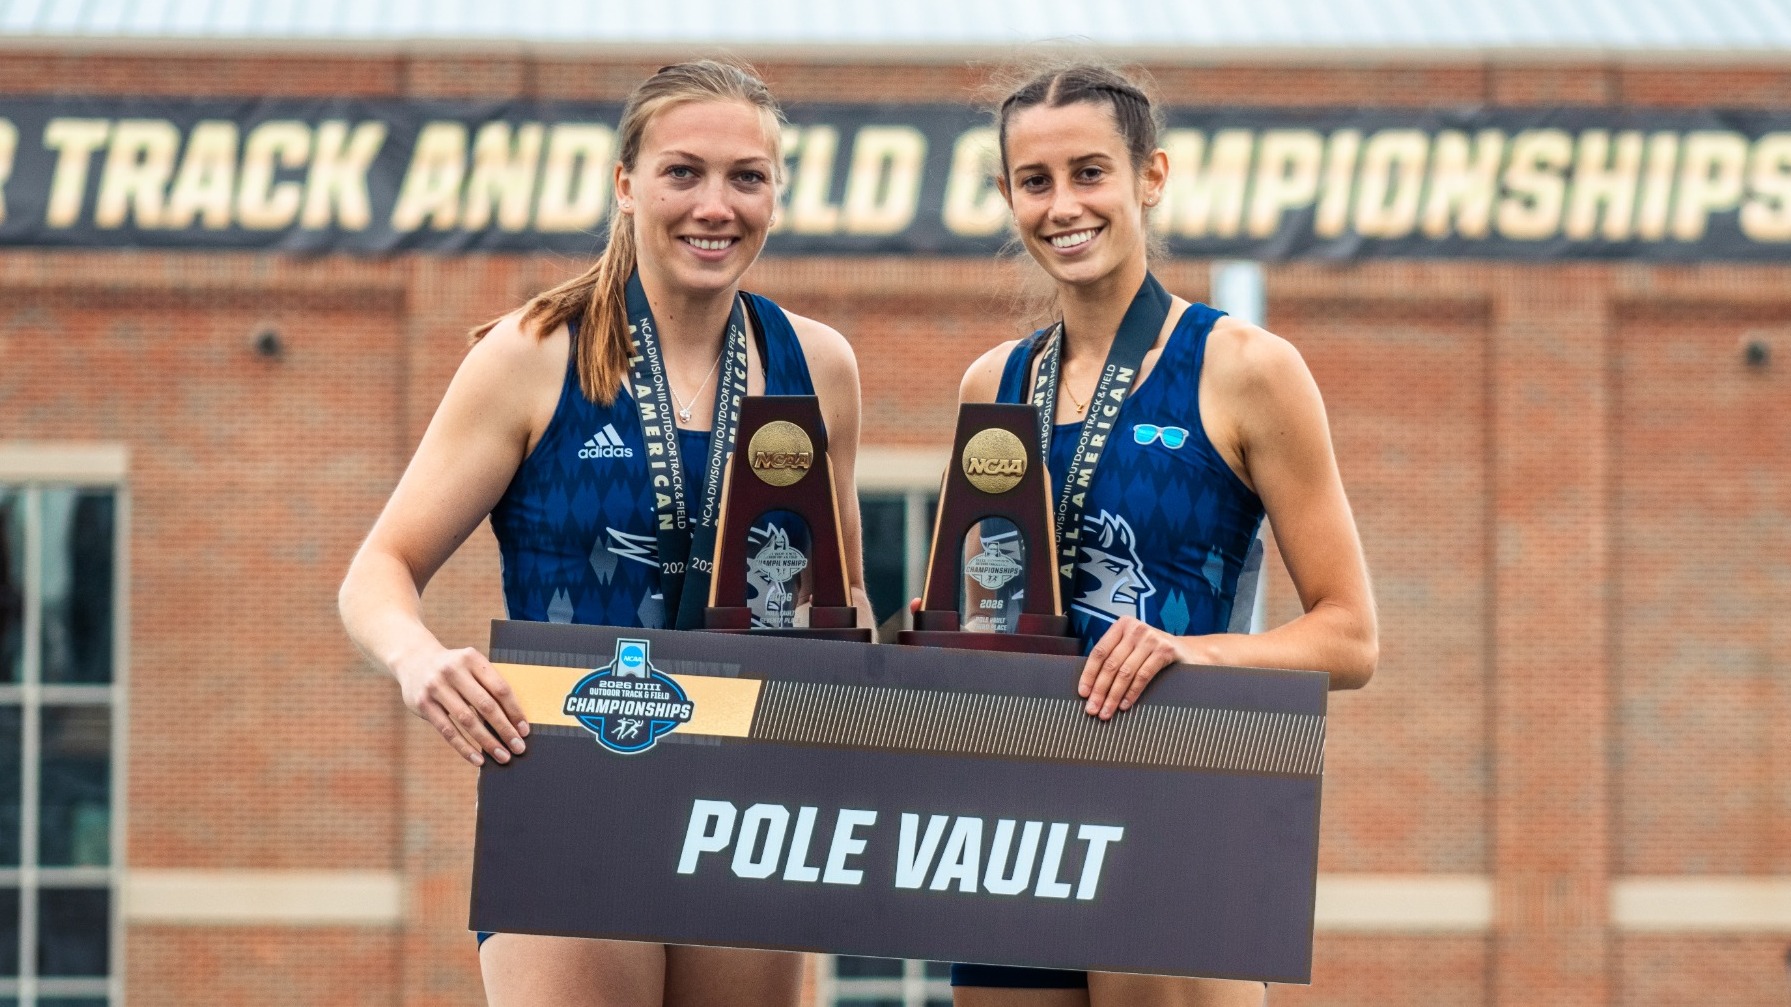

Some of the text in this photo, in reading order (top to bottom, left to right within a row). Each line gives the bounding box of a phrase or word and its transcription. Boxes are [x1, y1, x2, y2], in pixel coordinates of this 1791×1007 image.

[41, 117, 388, 231] TRACK
[391, 121, 617, 233] AND
[941, 124, 1791, 244] CMPIONSHIPS
[1100, 364, 1116, 391] FIELD
[1097, 391, 1106, 400] &
[640, 317, 687, 530] NCAA DIVISION III OUTDOOR TRACK & FIELD
[1085, 399, 1103, 431] TRACK
[702, 324, 737, 527] NCAA DIVISION III OUTDOOR TRACK & FIELD
[578, 445, 634, 459] adidas
[754, 451, 810, 470] NCAA
[1067, 430, 1090, 484] OUTDOOR
[967, 457, 1024, 477] NCAA
[1060, 366, 1135, 579] ALL-AMERICAN
[1063, 484, 1073, 494] III
[662, 561, 688, 574] 202
[691, 557, 713, 574] 202
[980, 599, 1004, 609] 2026
[623, 655, 642, 663] NCAA
[589, 687, 670, 700] OUTDOOR TRACK & FIELD
[599, 680, 662, 691] 2026 DIII
[566, 697, 691, 719] CHAMPIONSHIPS
[677, 799, 1124, 900] POLE VAULT
